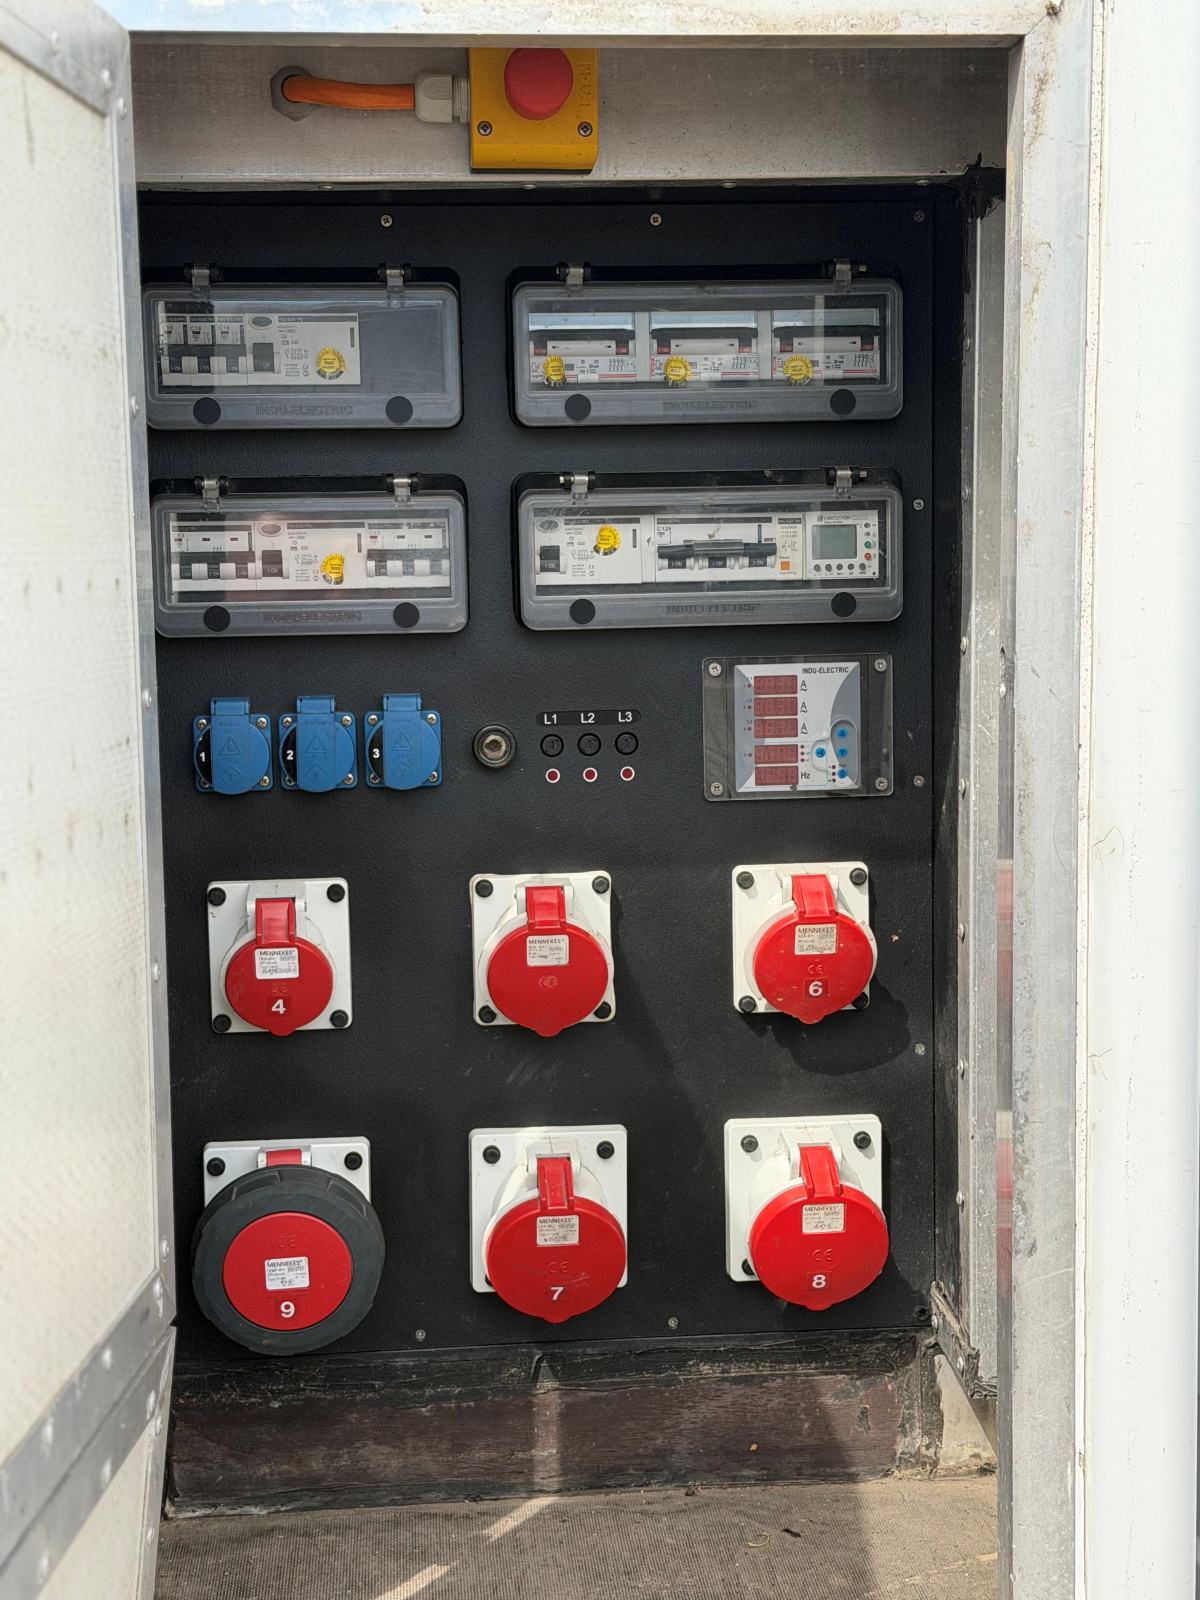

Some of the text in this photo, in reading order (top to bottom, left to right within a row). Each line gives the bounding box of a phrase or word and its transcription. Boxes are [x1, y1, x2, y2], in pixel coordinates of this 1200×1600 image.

[801, 666, 849, 675] INDU-ELECTRIC
[544, 711, 633, 725] L1 L2 L3
[199, 751, 206, 762] 1
[286, 750, 294, 760] 2
[372, 748, 380, 759] 3
[800, 772, 811, 780] Hz
[808, 981, 823, 997] 6
[271, 998, 287, 1014] 4
[266, 1260, 300, 1268] MENNEKES
[811, 1274, 826, 1289] 8
[550, 1286, 564, 1301] 7
[280, 1301, 295, 1318] 9
